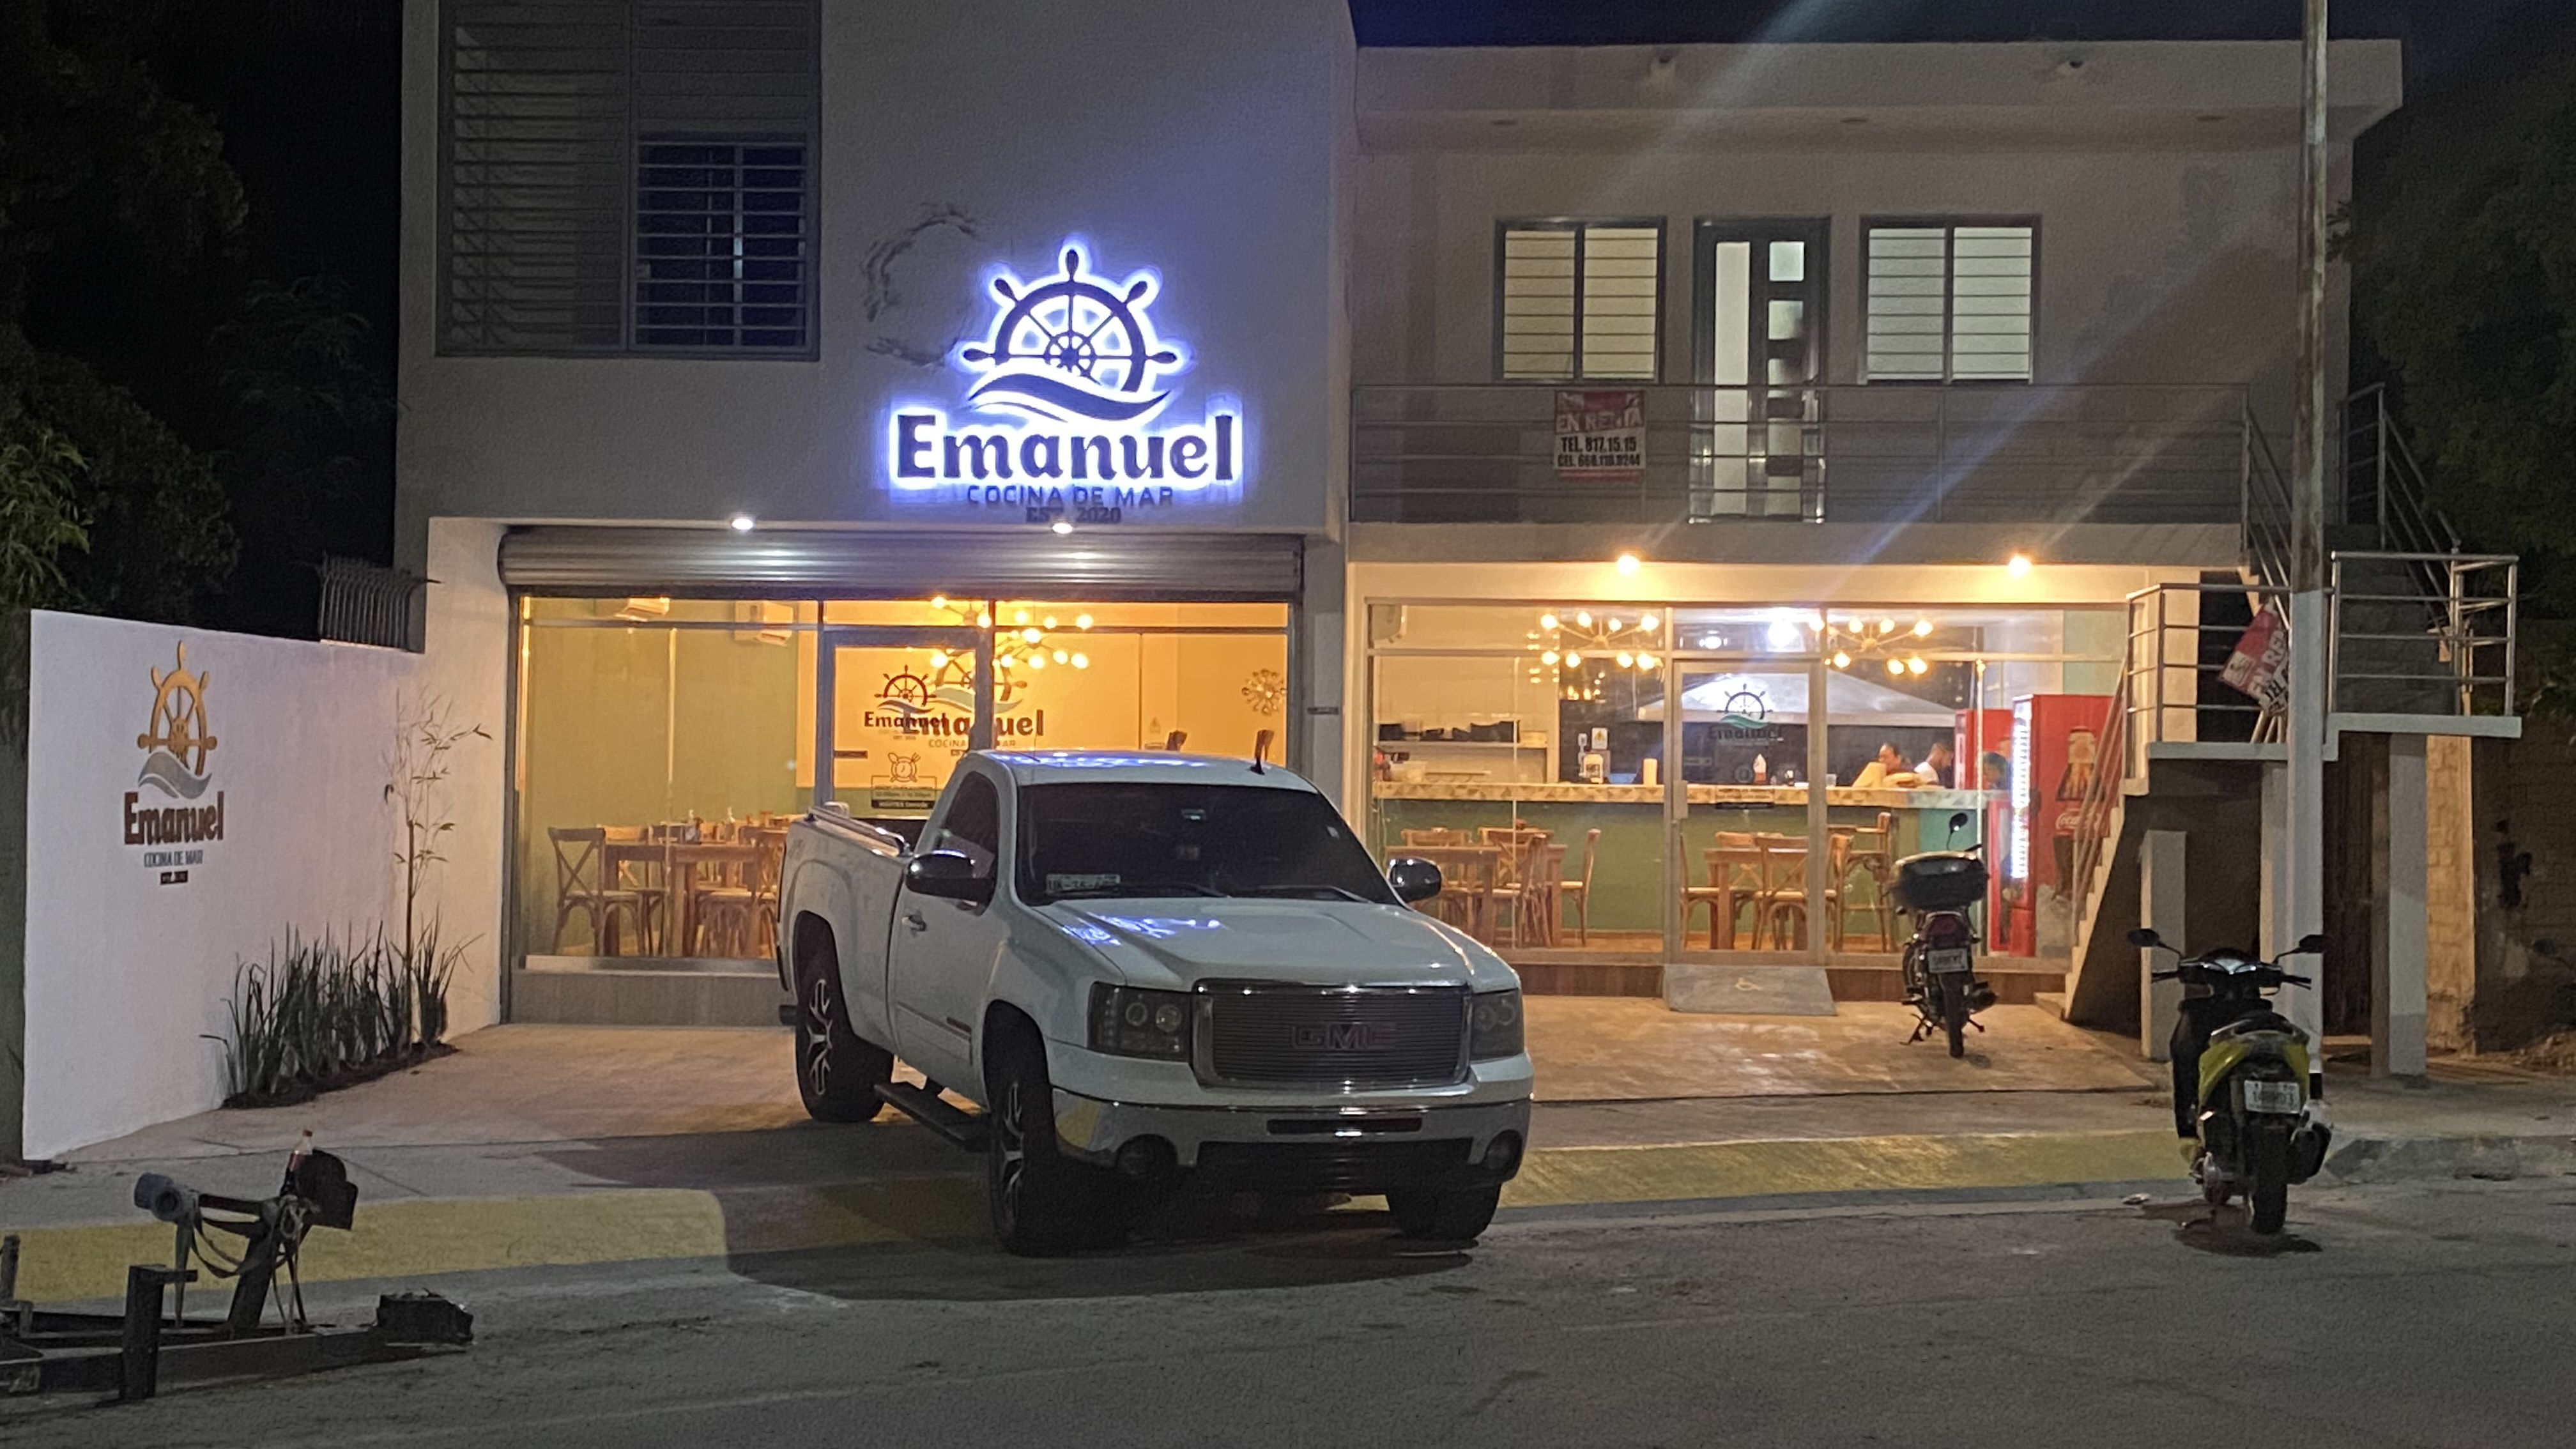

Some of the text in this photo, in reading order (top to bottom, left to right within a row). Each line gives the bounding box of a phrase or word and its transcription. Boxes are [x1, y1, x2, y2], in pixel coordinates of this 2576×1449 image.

[897, 413, 1233, 480] Emanuel
[967, 485, 1174, 507] COCINA DE MAR
[1076, 507, 1122, 524] 2020
[124, 791, 224, 845] Emanuel
[144, 849, 204, 868] COCINA DE MAR
[1289, 1022, 1397, 1050] GMC
